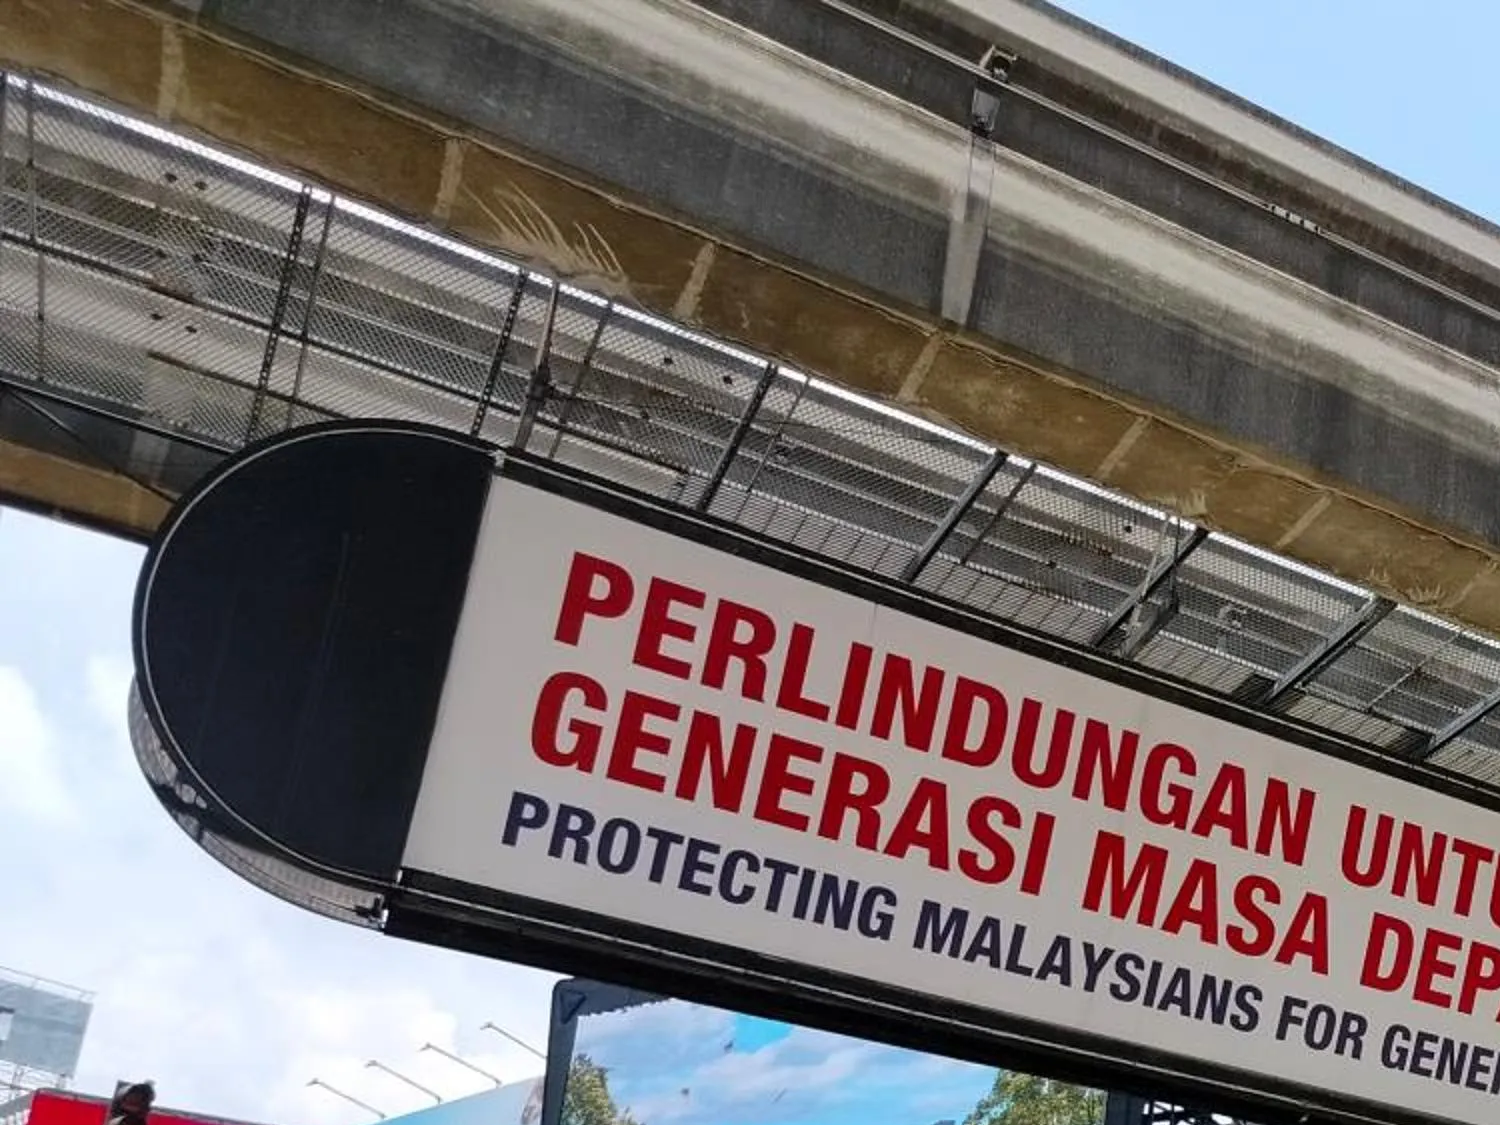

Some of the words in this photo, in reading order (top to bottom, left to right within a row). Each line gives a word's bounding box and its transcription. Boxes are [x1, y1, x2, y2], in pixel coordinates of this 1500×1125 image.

[531, 671, 1056, 896] GENERASI
[1081, 830, 1330, 976] MASA
[553, 551, 1317, 867] PERLINDUNGAN
[501, 791, 898, 942] PROTECTING
[912, 899, 1263, 1033] MALAYSIANS
[1275, 995, 1368, 1061] FOR
